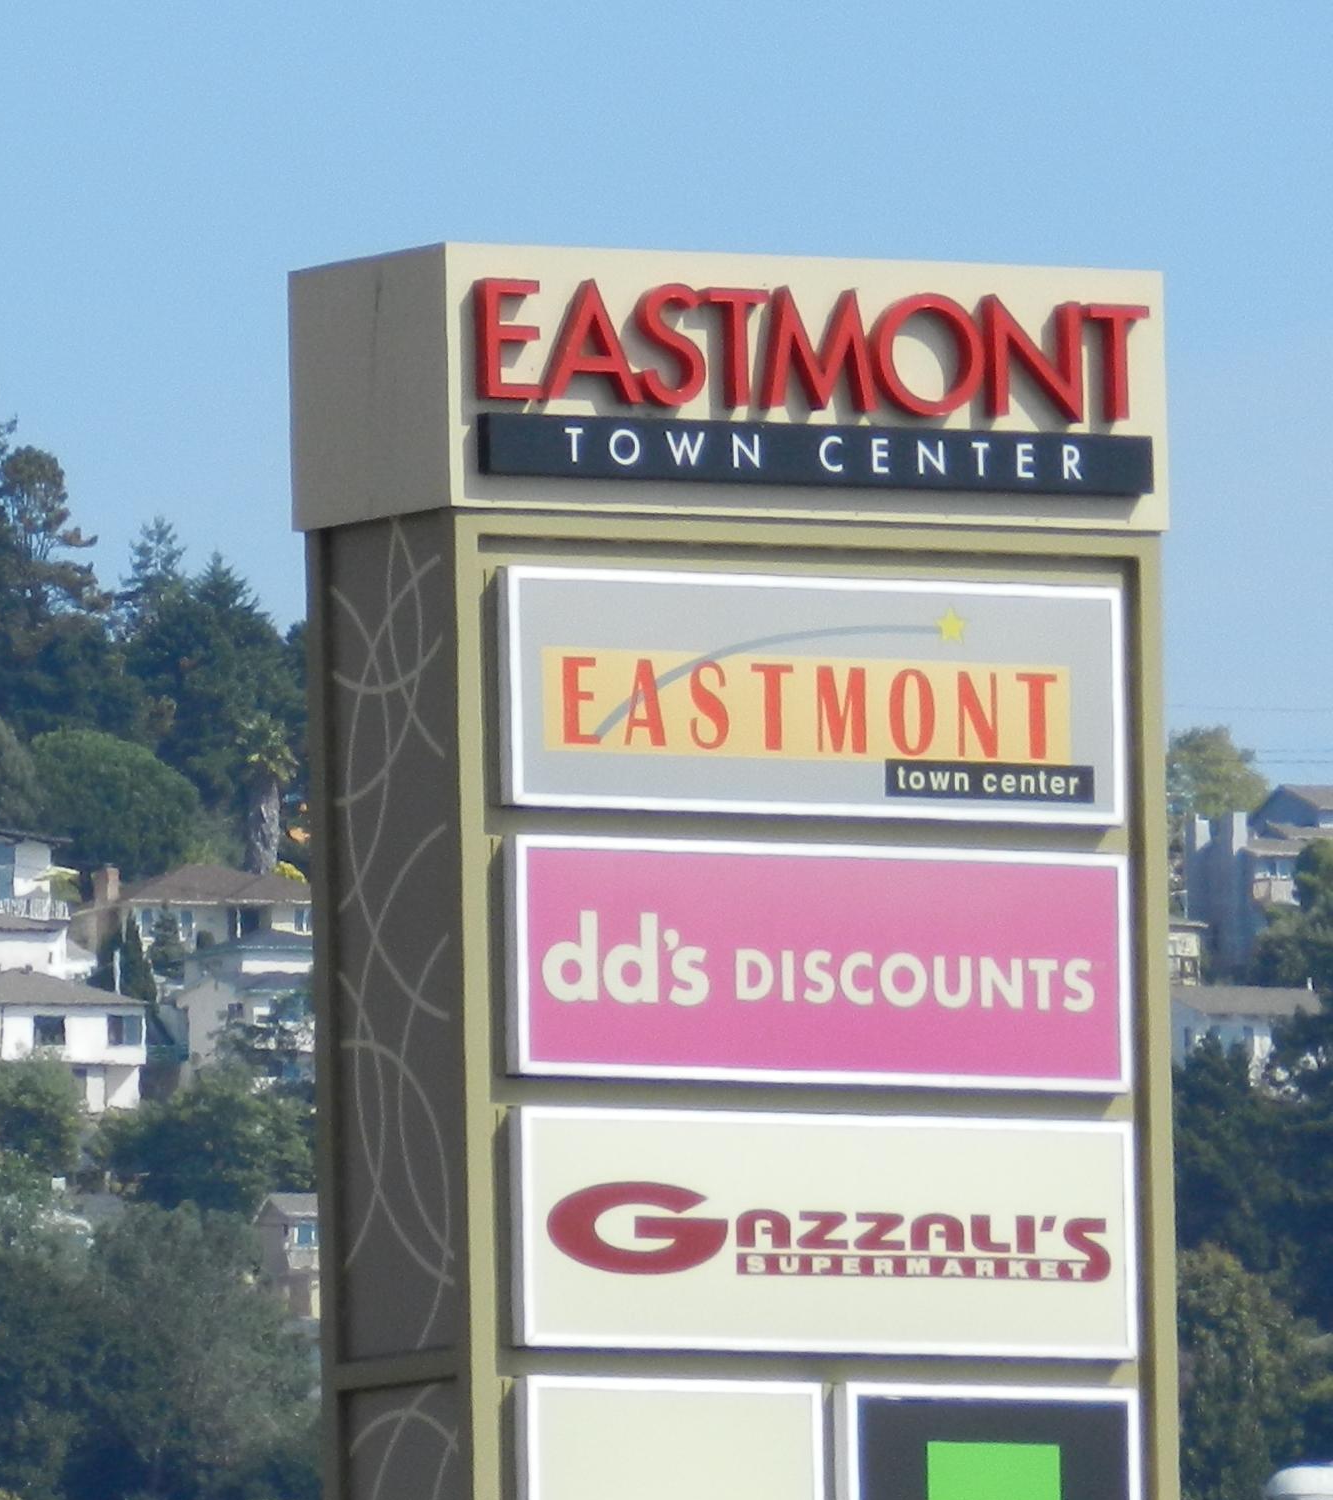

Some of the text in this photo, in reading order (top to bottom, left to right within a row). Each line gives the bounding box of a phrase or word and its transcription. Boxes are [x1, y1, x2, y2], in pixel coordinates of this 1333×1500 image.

[475, 278, 1149, 422] EASTMONT
[565, 426, 1084, 481] TOWN CENTER
[561, 656, 1058, 760] EASTMONT
[896, 766, 1080, 797] town center
[541, 910, 1096, 1013] dd's DISCOUNTS
[546, 1180, 1112, 1283] GAZZALI'S
[744, 1254, 1088, 1281] SUPERMARKET
